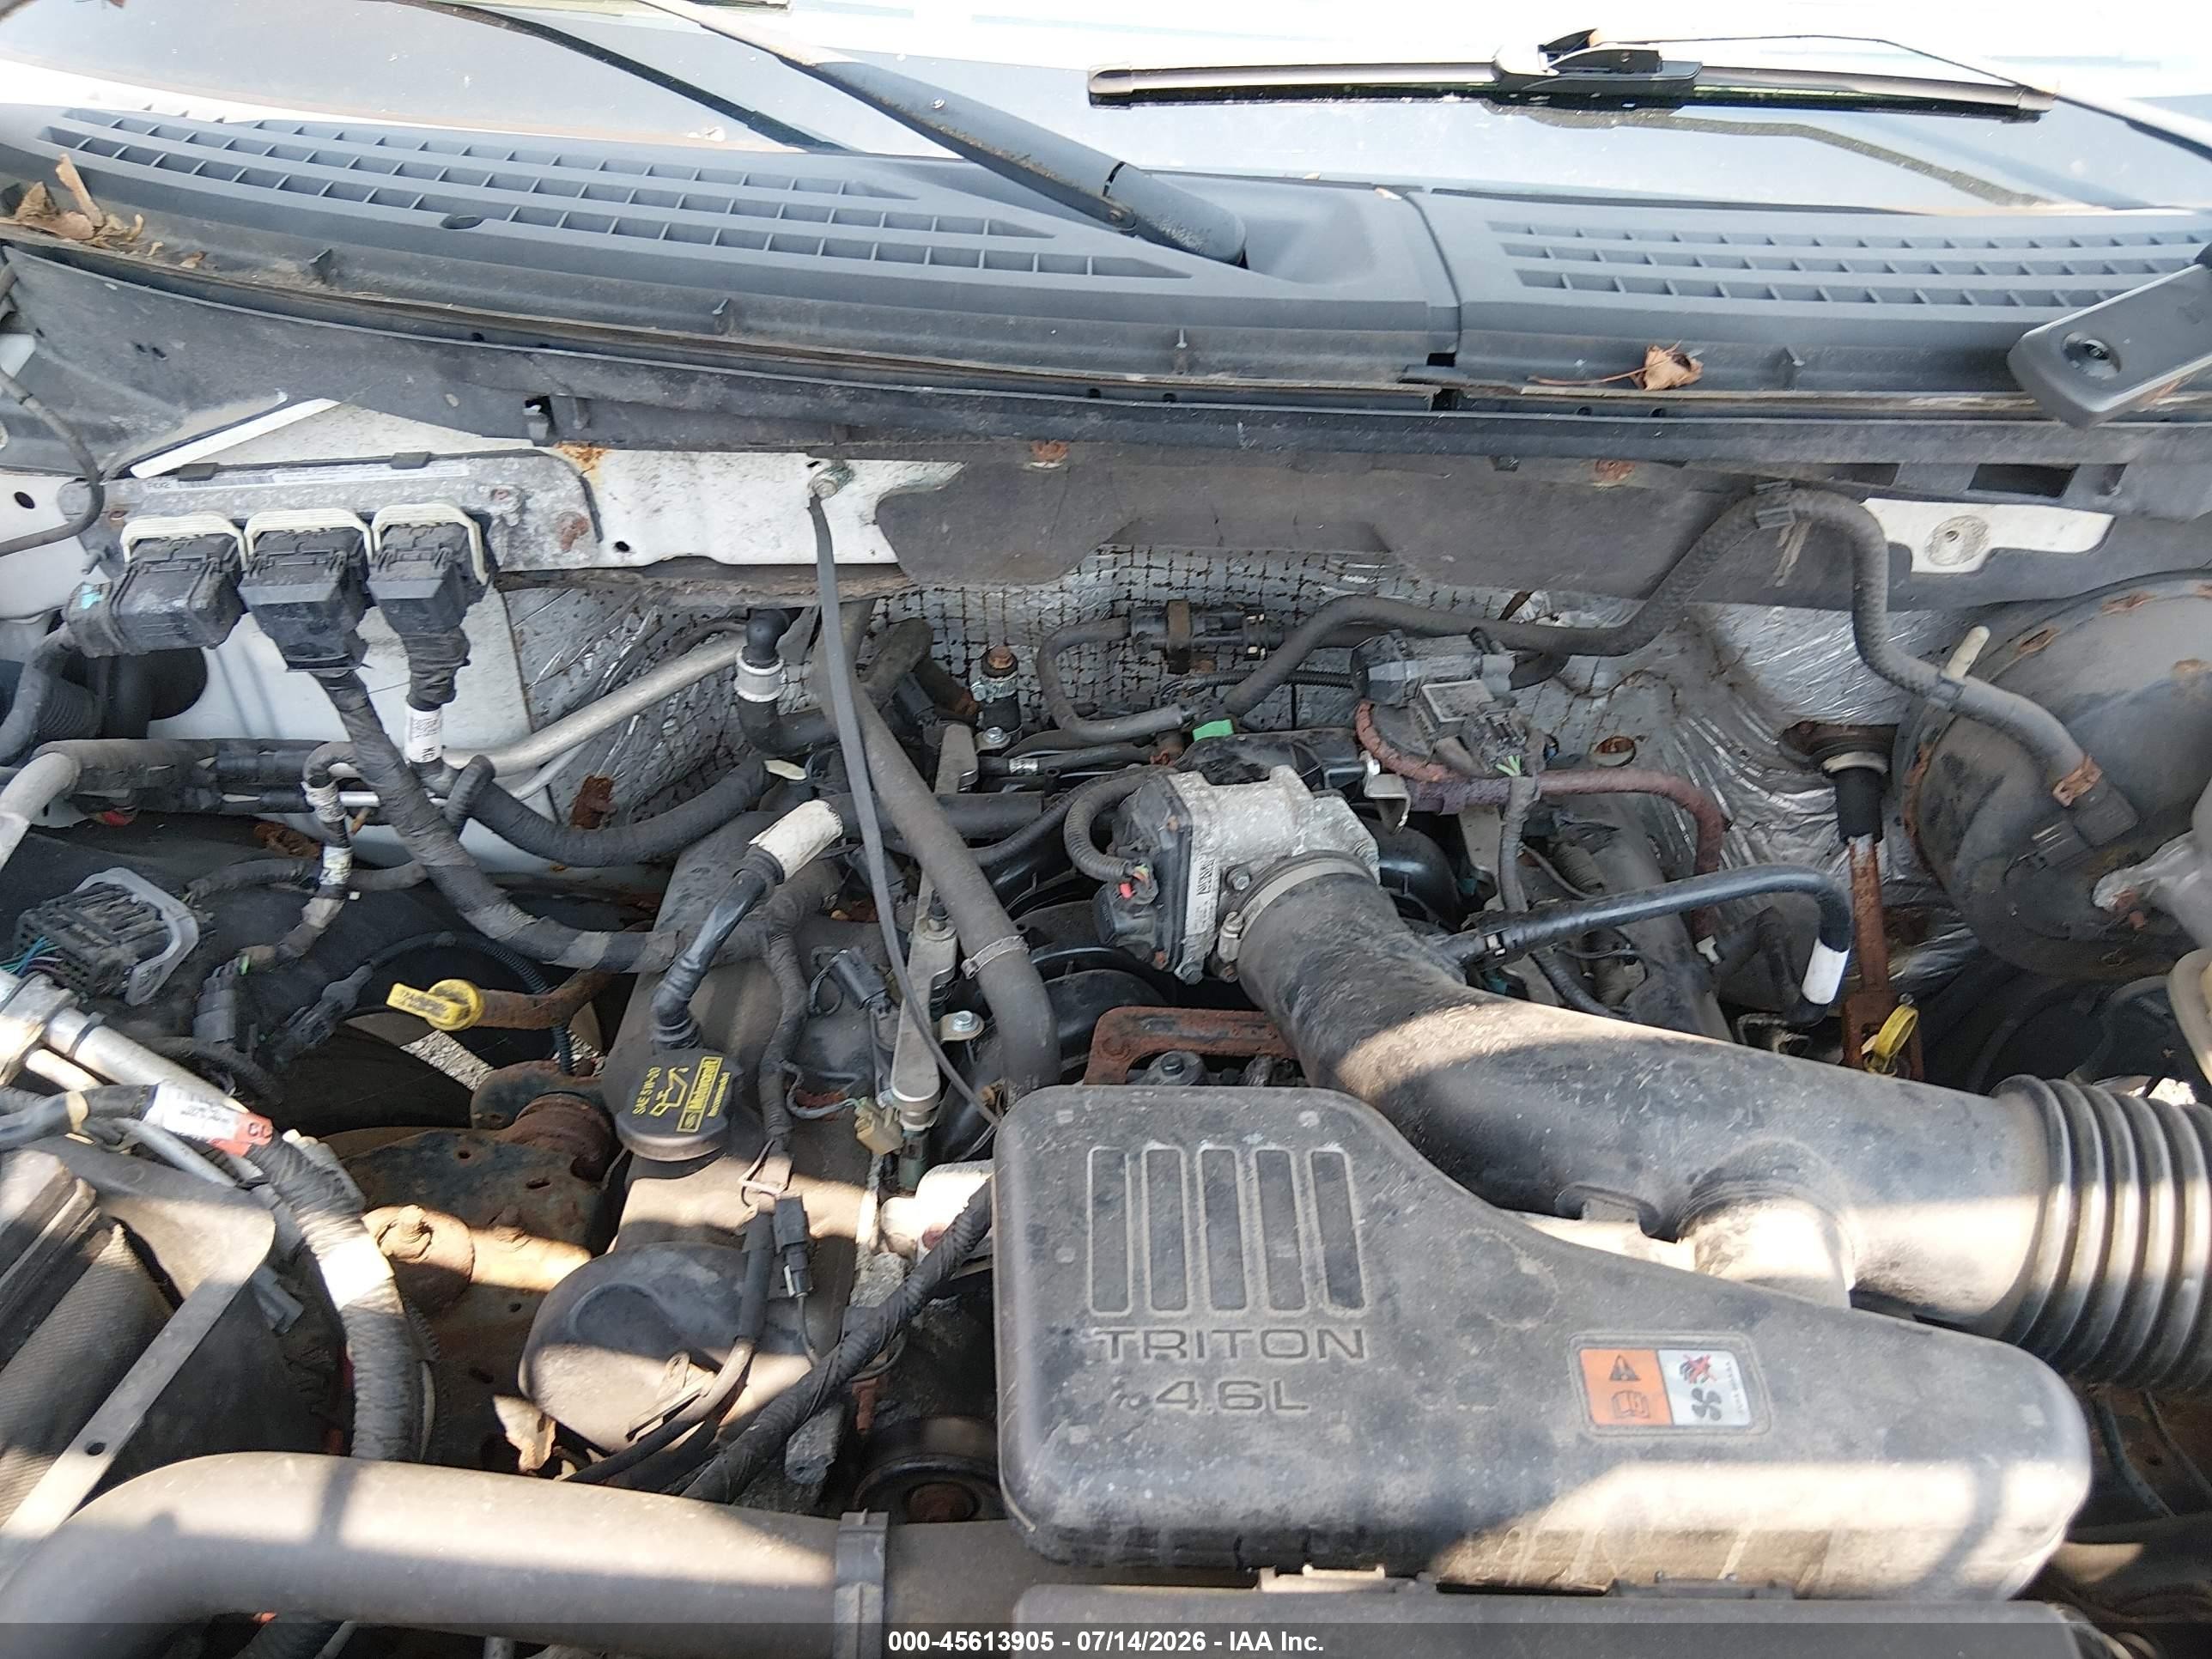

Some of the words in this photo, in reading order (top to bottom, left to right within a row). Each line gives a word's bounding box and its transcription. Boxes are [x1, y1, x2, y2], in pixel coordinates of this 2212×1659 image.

[687, 1059, 719, 1110] Motorcraft
[632, 1096, 651, 1115] SAE
[1093, 1328, 1364, 1359] TRITON
[1154, 1379, 1310, 1412] 4.6L
